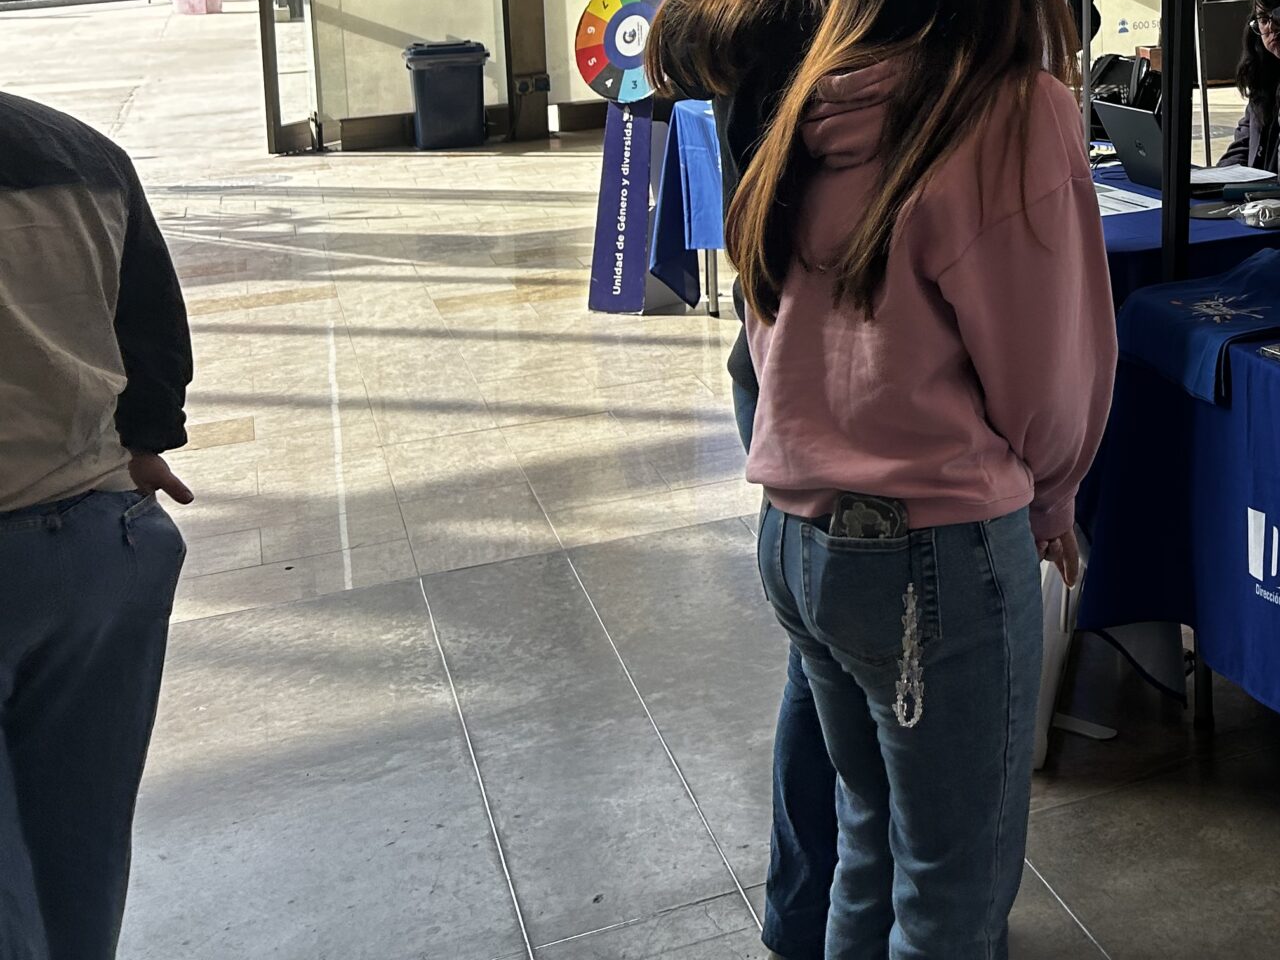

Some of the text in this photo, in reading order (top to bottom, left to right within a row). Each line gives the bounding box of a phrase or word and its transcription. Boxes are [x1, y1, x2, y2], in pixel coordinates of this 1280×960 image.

[602, 0, 609, 10] 7
[1132, 21, 1150, 30] 600
[588, 57, 597, 66] 5
[605, 78, 614, 88] 4
[631, 80, 638, 90] 3
[612, 114, 634, 295] Unidad de Género y diversida
